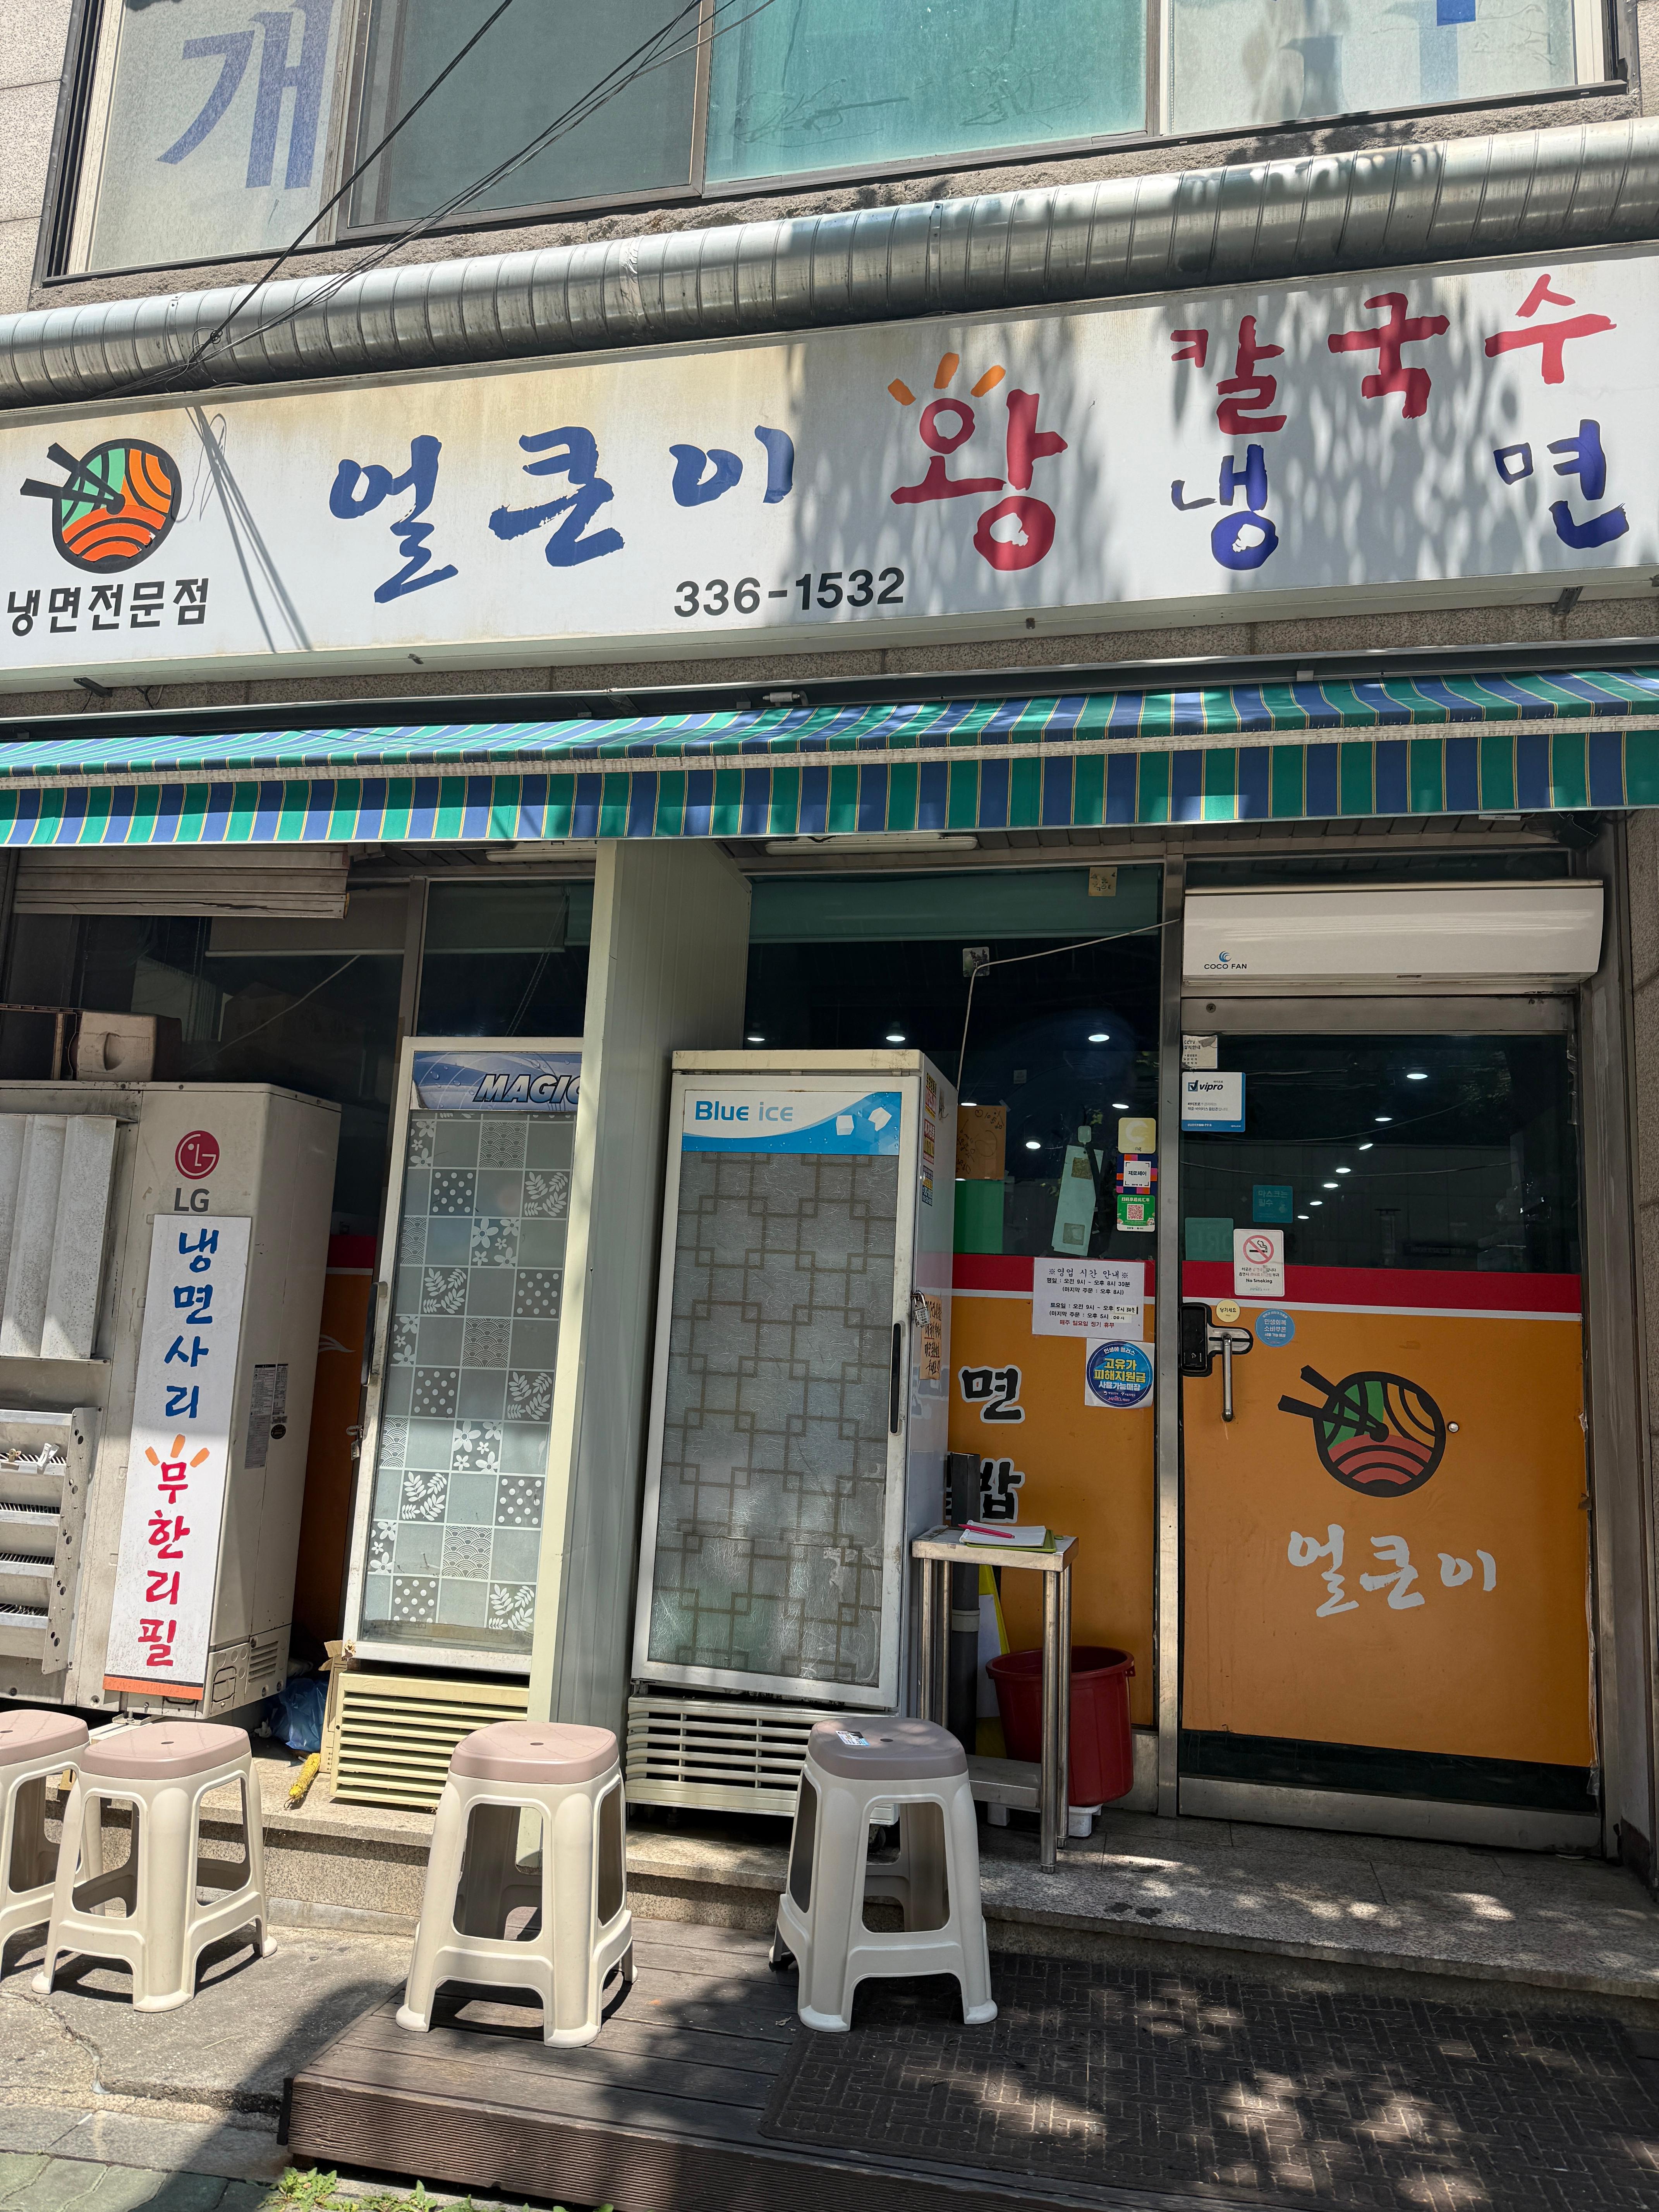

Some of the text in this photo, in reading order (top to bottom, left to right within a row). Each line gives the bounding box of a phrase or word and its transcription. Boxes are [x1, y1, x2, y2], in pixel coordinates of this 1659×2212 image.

[1171, 274, 1617, 435] 칼국수
[329, 389, 1068, 603] 얼큰이 왕
[1171, 419, 1629, 570] 냉면
[8, 578, 209, 637] 냉면전문점
[674, 567, 904, 617] 336-1532
[695, 1101, 793, 1121] Blue ice
[1200, 1082, 1223, 1092] vipro
[174, 1188, 210, 1212] LG
[1080, 1269, 1097, 1278] 시간
[164, 1229, 219, 1419] 냉면사리
[1094, 1369, 1146, 1383] 피해지원금
[1099, 1381, 1141, 1391] 사용가능매장
[1104, 1358, 1137, 1371] 고유가
[962, 1368, 1022, 1420] 면
[138, 1462, 190, 1666] 무한리필
[1288, 1524, 1496, 1617] 얼큰이
